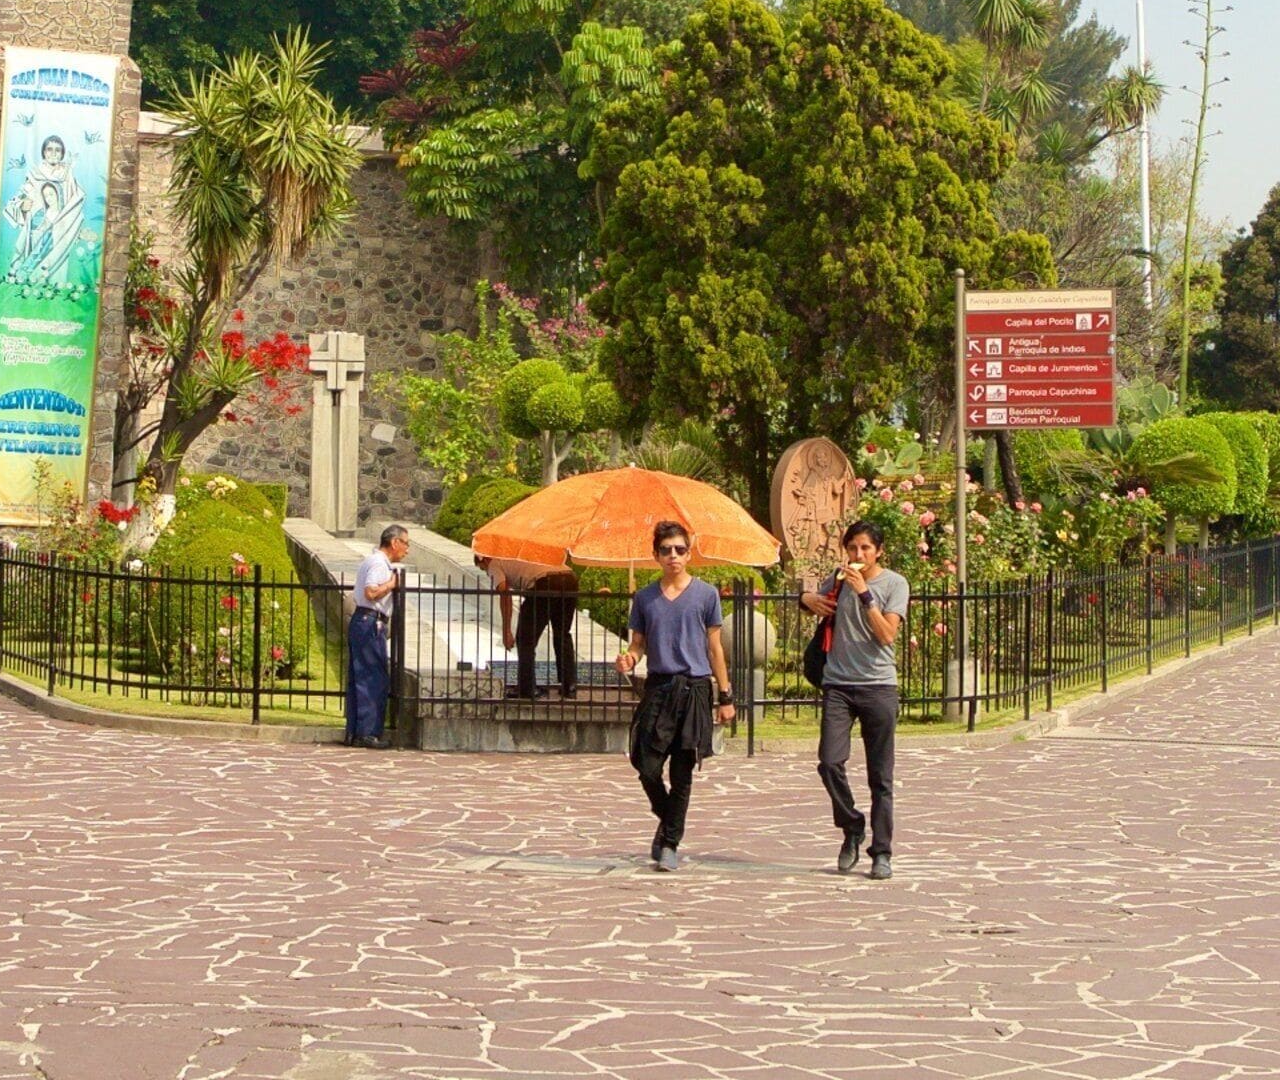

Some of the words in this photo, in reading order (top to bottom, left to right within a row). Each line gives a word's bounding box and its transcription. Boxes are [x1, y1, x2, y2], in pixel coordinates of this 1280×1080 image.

[11, 69, 36, 86] SAN
[37, 68, 69, 88] JUAN
[70, 70, 110, 93] DIEGO
[1005, 318, 1033, 327] Capilla
[1034, 318, 1047, 326] del
[1048, 317, 1073, 326] Pocito
[1009, 338, 1040, 347] Antigua
[1009, 346, 1047, 355] Parroquia
[1049, 345, 1059, 353] de
[1061, 344, 1086, 353] Indios
[1009, 364, 1036, 373] Capilla
[1038, 364, 1048, 372] de
[1050, 363, 1098, 372] Juramentos
[1009, 388, 1047, 397] Parroquia
[1049, 387, 1097, 397] Capuchinas
[1009, 416, 1037, 425] Oficina
[1039, 415, 1081, 424] Parroquial
